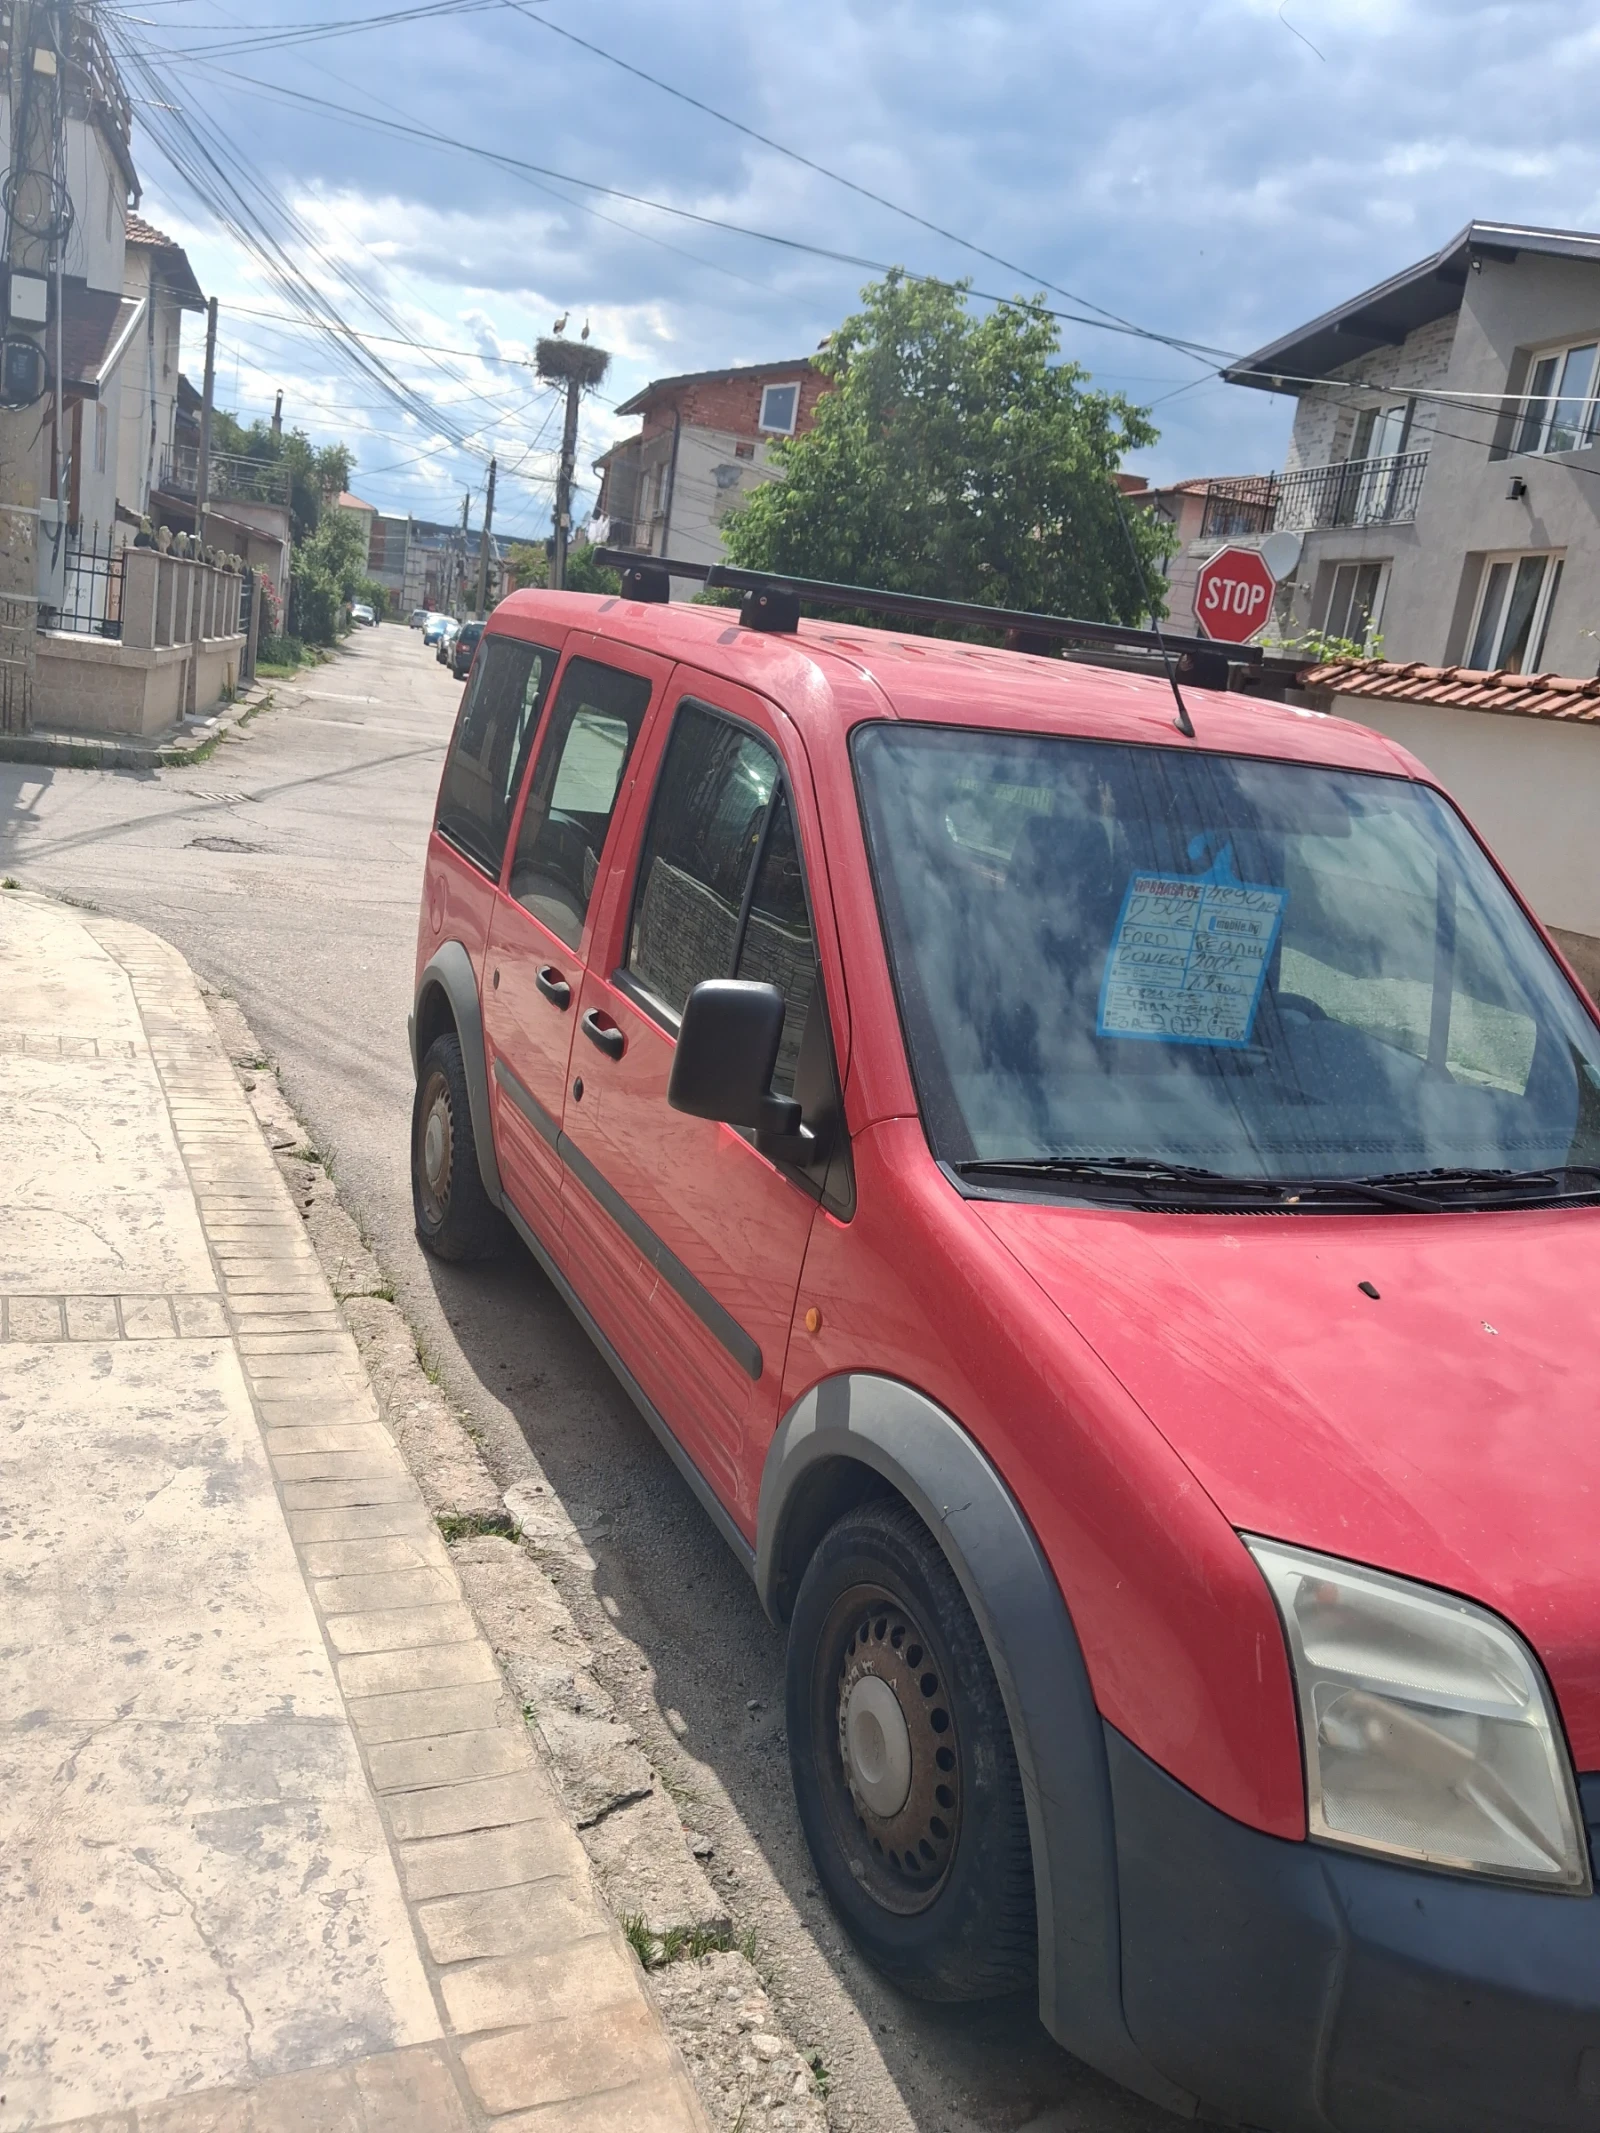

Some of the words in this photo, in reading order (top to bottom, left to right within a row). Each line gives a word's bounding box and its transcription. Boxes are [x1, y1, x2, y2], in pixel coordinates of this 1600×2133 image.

[1205, 577, 1265, 615] STOP
[1206, 884, 1264, 905] 4890
[1121, 925, 1169, 945] FORD
[1215, 919, 1260, 935] mobile.bg
